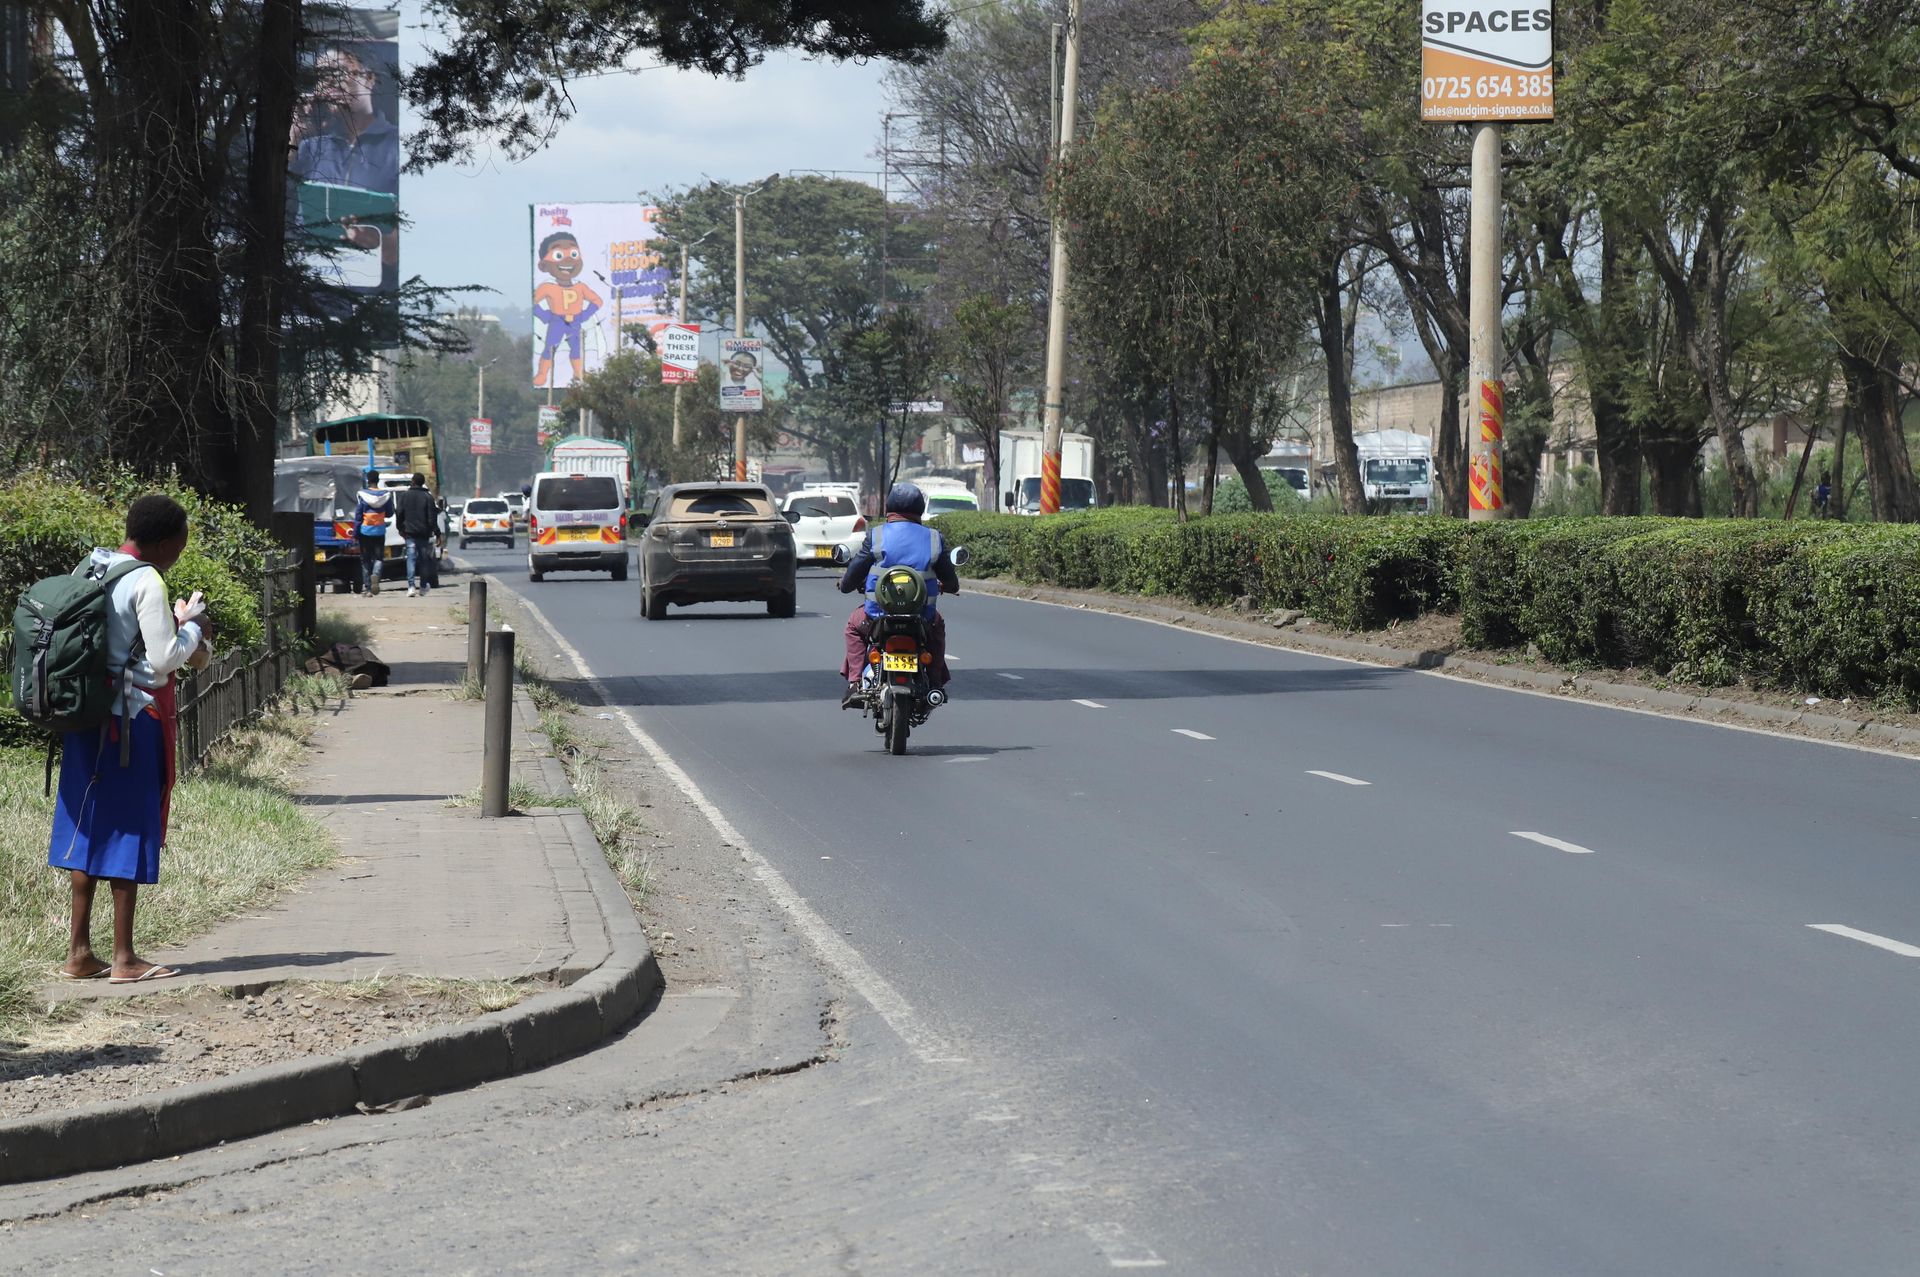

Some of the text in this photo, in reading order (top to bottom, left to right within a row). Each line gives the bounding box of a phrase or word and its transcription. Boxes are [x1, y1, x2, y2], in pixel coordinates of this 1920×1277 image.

[1425, 9, 1551, 33] SPACES
[1423, 75, 1553, 99] 0725 654 385
[1423, 103, 1553, 117] sales@nudgim-signage.co.ke
[668, 333, 695, 341] BOOK
[664, 353, 699, 361] SPACES
